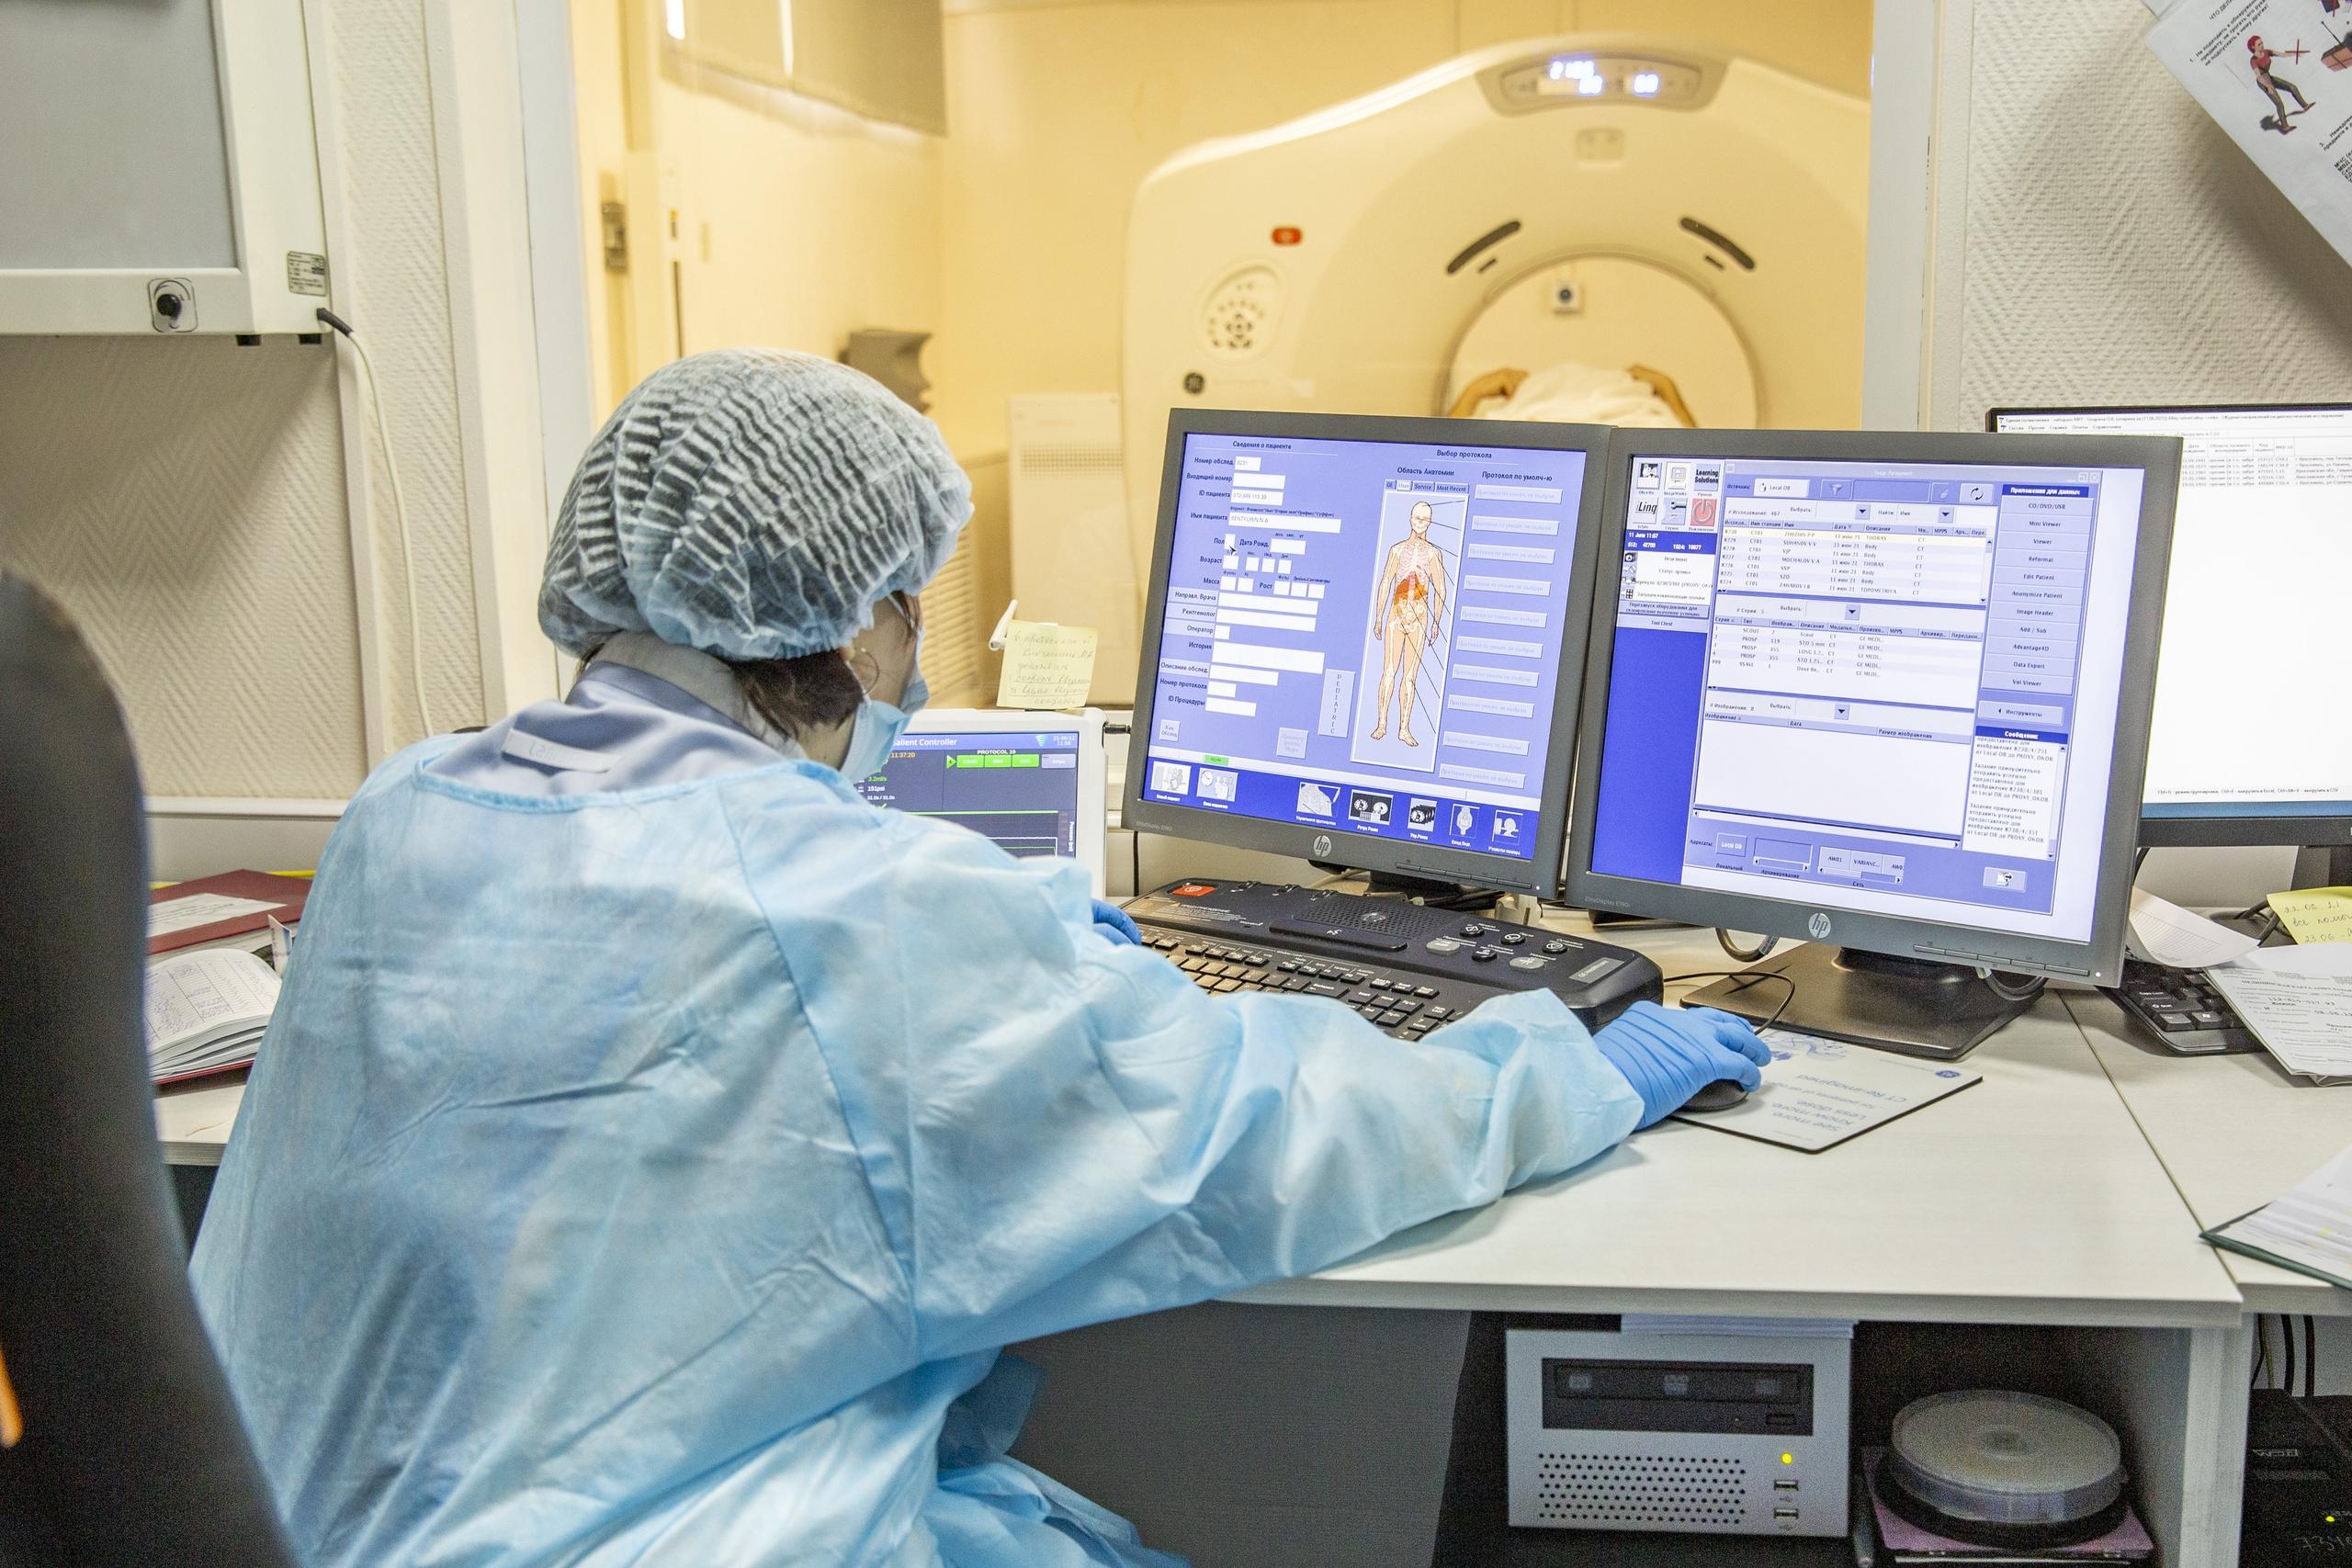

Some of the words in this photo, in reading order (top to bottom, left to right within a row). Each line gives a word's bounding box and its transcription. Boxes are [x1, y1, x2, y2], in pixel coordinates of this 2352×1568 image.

[1233, 440, 1259, 449] Сведения
[1437, 449, 1458, 457] Выбор
[1459, 451, 1492, 459] протокола
[1194, 457, 1213, 465] Номер
[1397, 467, 1422, 475] Область
[1424, 468, 1454, 477] Анатомии
[1482, 471, 1513, 480] Протокол
[1696, 468, 1718, 477] Learning
[1186, 473, 1214, 482] Входящий
[1203, 513, 1227, 522] пациента
[1239, 539, 1251, 547] Дата
[1200, 556, 1222, 565] Возраст
[1260, 582, 1272, 591] Рост
[1199, 593, 1216, 602] Врача
[1182, 608, 1216, 618] Рентгенолог
[1187, 626, 1214, 636] Оператор
[1189, 641, 1212, 650] История
[1160, 662, 1187, 671] Описание
[1159, 679, 1178, 687] Номер
[1179, 681, 1207, 691] протокола
[1175, 696, 1205, 707] Процедуры
[1330, 674, 1342, 735] PEDIATRIC
[2006, 709, 2042, 717] Инструменты
[919, 737, 957, 746] Controller
[1721, 840, 1734, 849] Local
[1715, 863, 1743, 872] Локальный
[1761, 869, 1800, 879] Архивирование
[1809, 913, 1831, 938] hp
[1793, 1075, 1885, 1098] Re-imagined
[1772, 1103, 1810, 1116] more
[1796, 1100, 1832, 1111] dose
[1772, 1112, 1810, 1124] more
[1812, 1113, 1853, 1126] Know
[1835, 1109, 1867, 1121] Less
[1813, 1122, 1840, 1132] See
